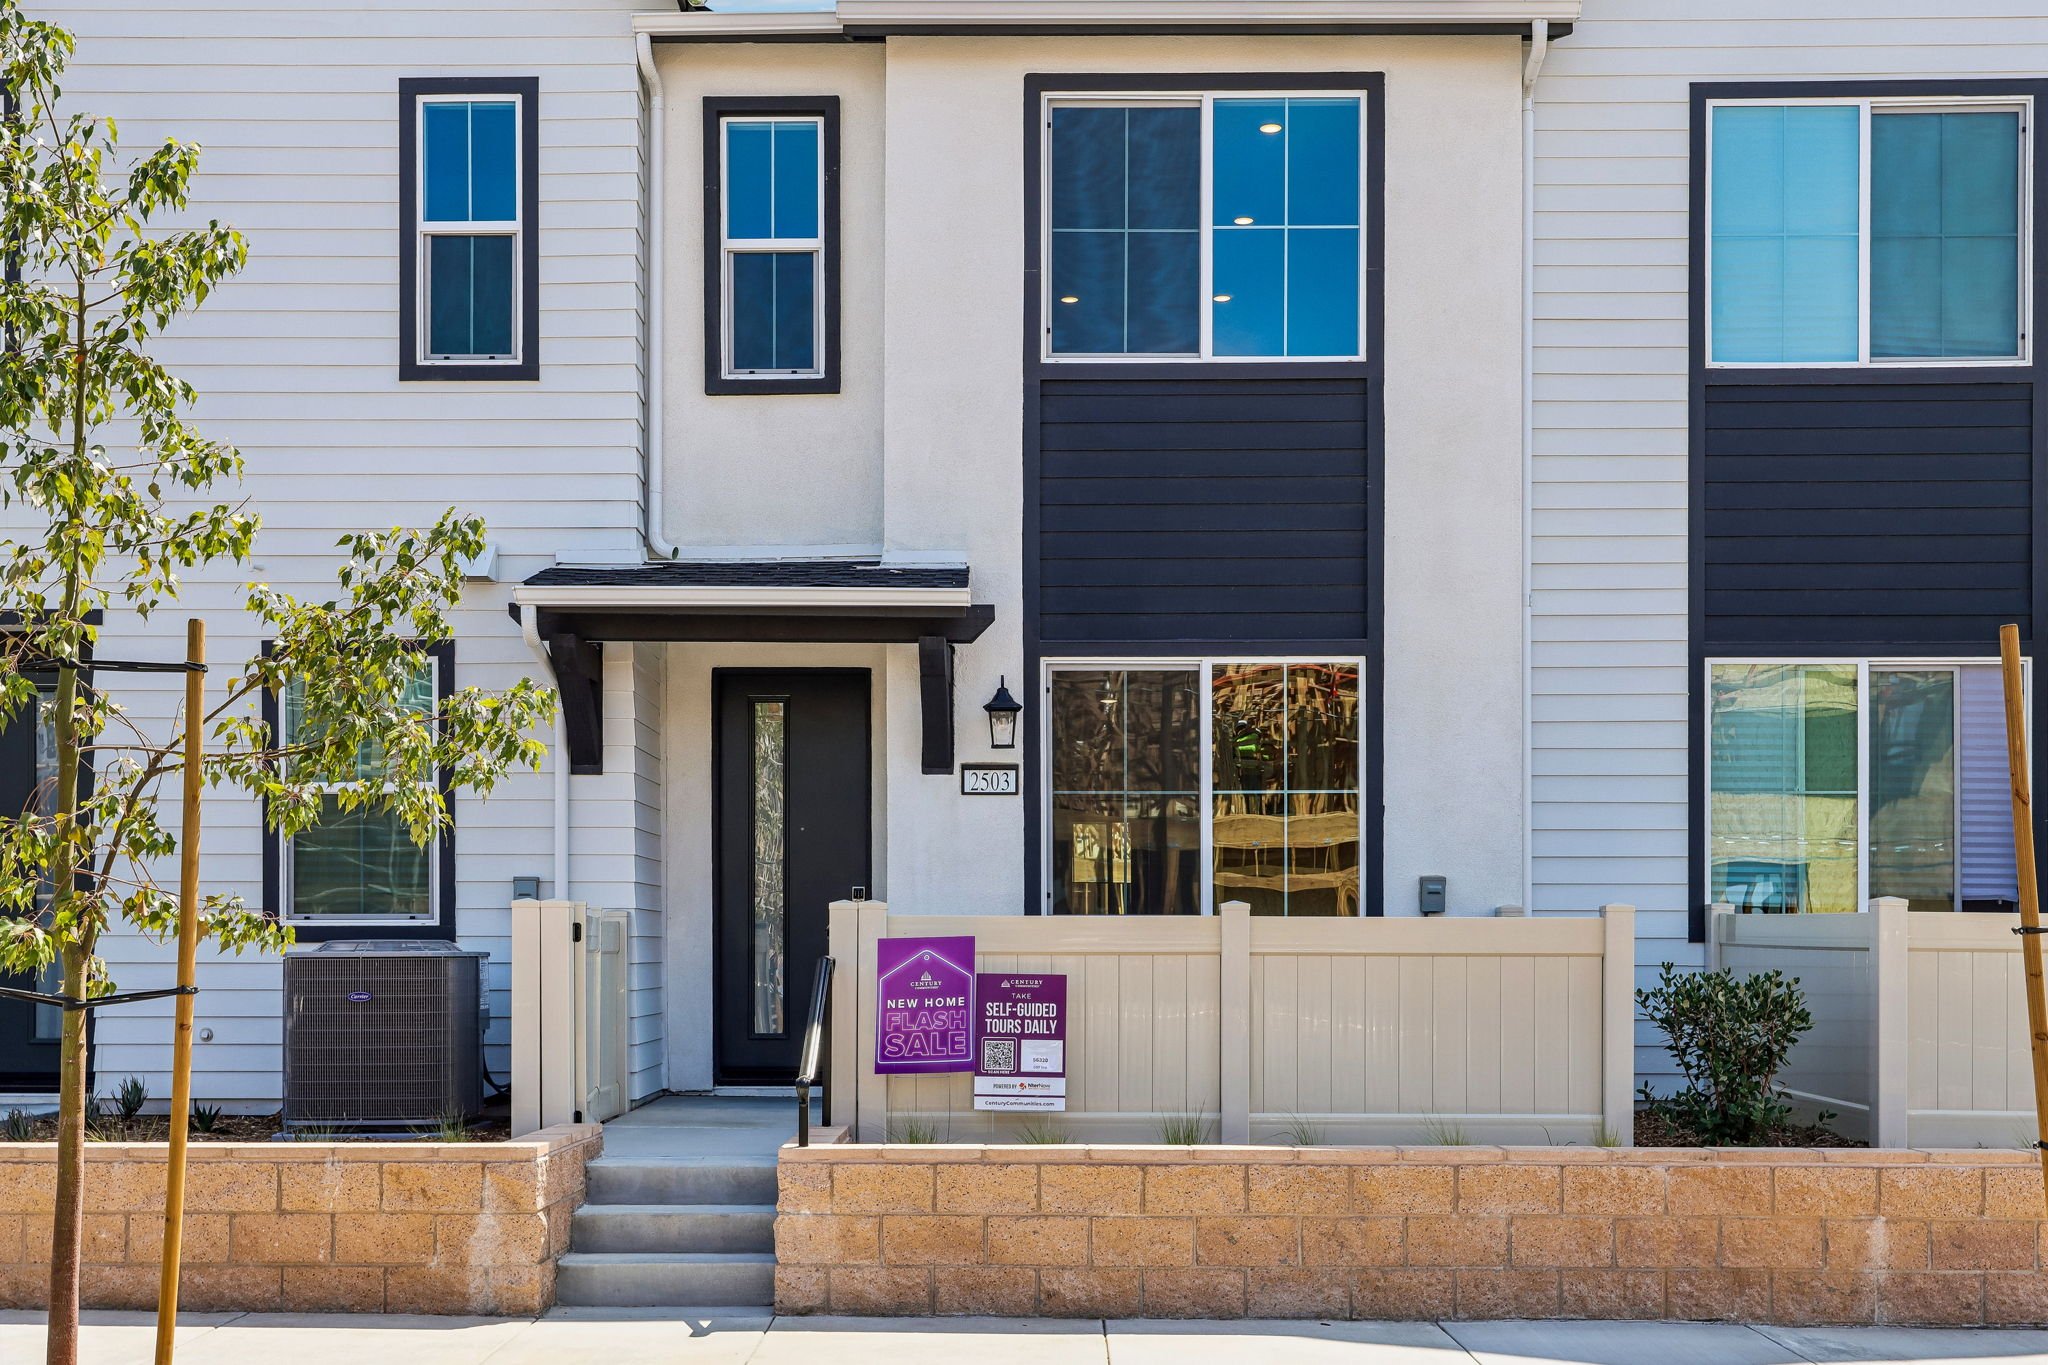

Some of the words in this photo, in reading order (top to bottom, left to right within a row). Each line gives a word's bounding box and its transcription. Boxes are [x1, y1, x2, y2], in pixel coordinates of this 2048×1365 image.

[970, 772, 1010, 791] 2503
[888, 999, 918, 1008] NEW
[925, 997, 965, 1007] HOME
[986, 1002, 1056, 1017] SELF-GUIDED
[886, 1010, 966, 1031] FLASH
[985, 1019, 1021, 1033] TOURS
[1024, 1020, 1057, 1034] DAILY
[884, 1031, 966, 1057] SALE
